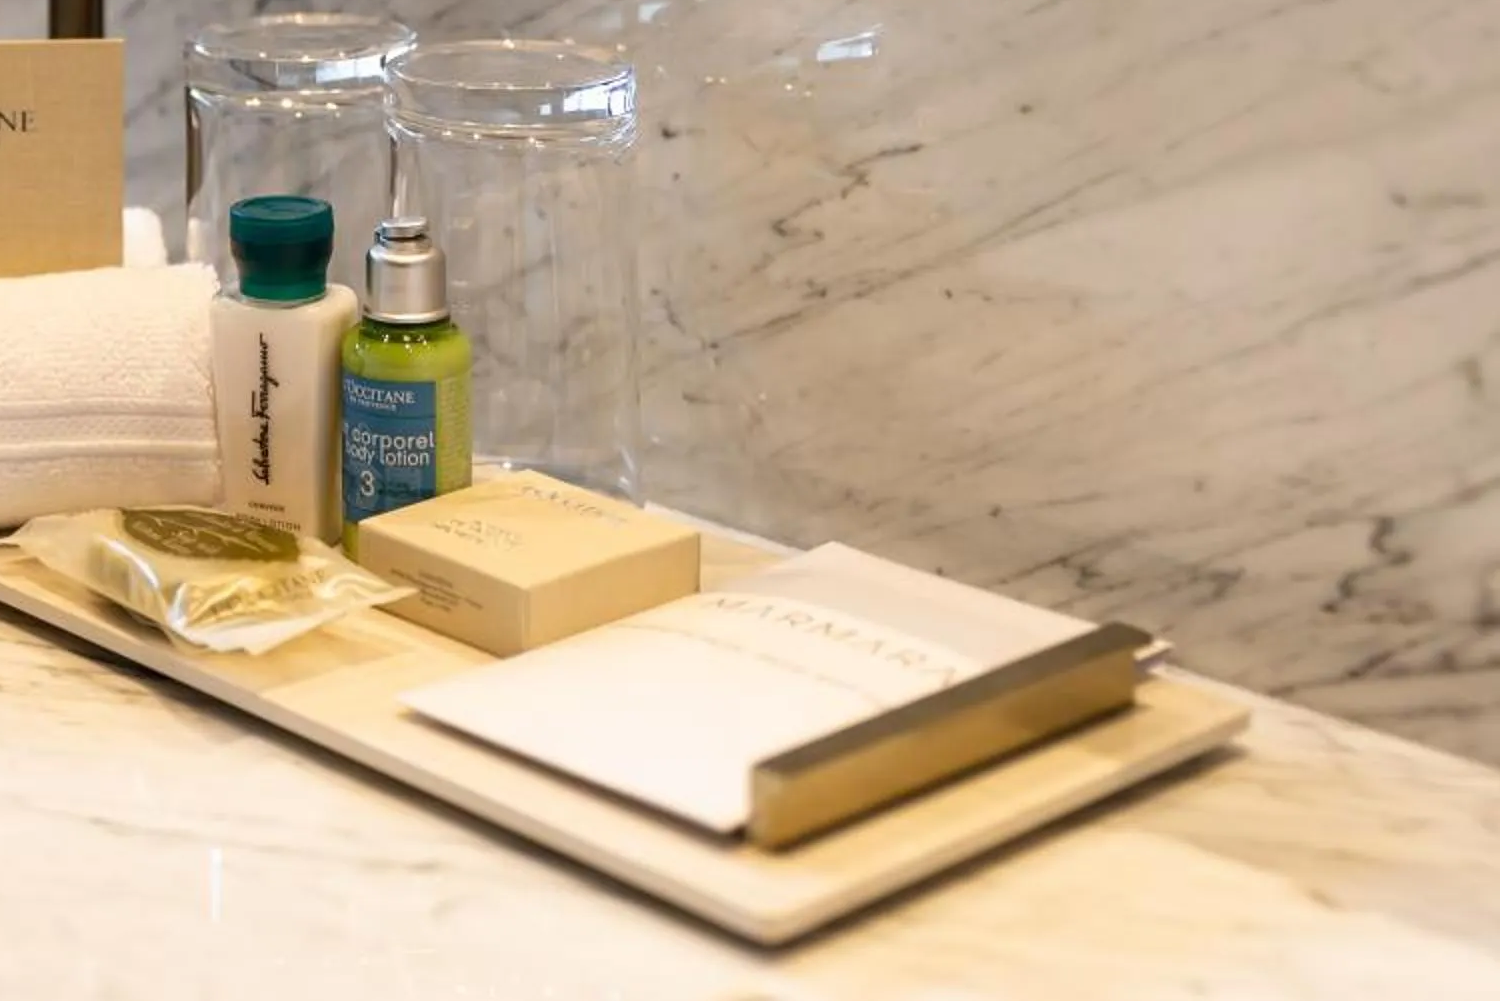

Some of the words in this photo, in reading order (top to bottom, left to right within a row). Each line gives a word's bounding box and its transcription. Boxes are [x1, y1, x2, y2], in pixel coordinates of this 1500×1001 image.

[351, 427, 435, 455] corporel
[379, 447, 430, 467] lotion
[361, 470, 375, 497] 3
